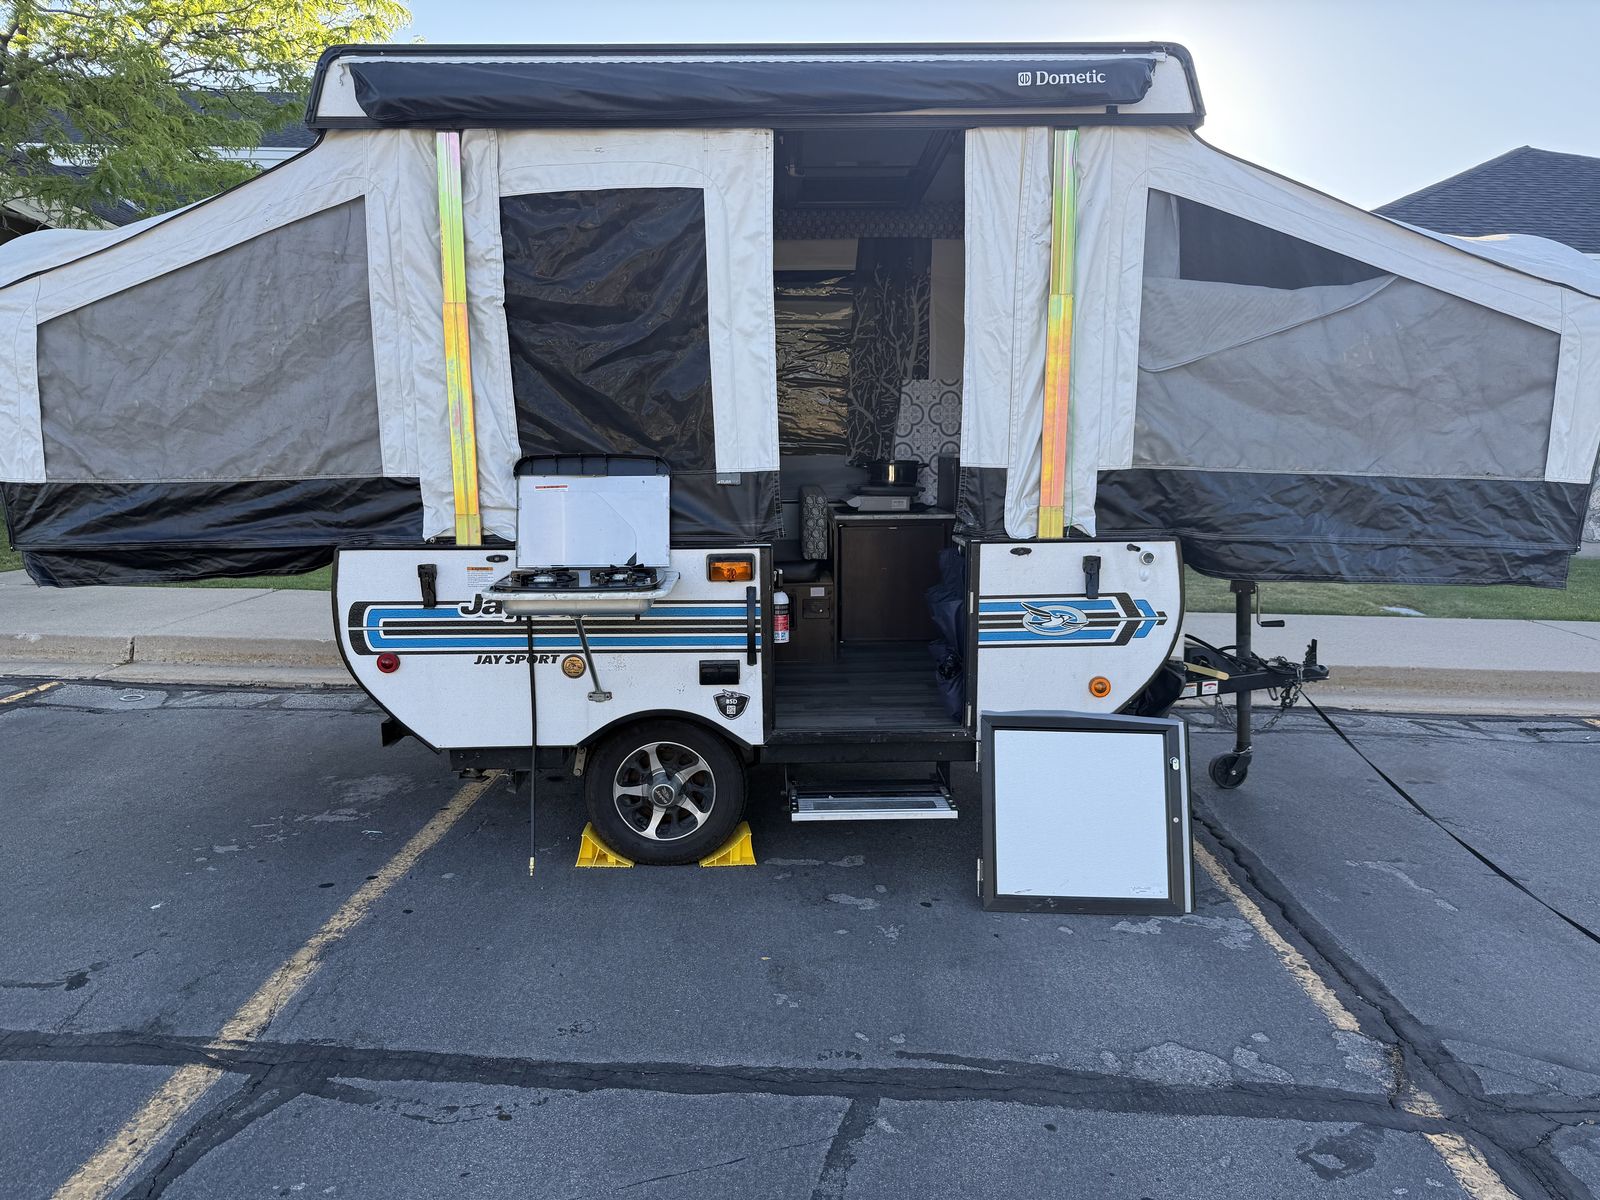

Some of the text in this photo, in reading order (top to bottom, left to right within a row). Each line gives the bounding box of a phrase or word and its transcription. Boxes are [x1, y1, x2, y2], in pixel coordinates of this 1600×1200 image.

[1036, 69, 1106, 86] Dometic
[460, 594, 517, 619] Ja
[474, 655, 504, 665] JAY
[505, 654, 560, 665] SPORT
